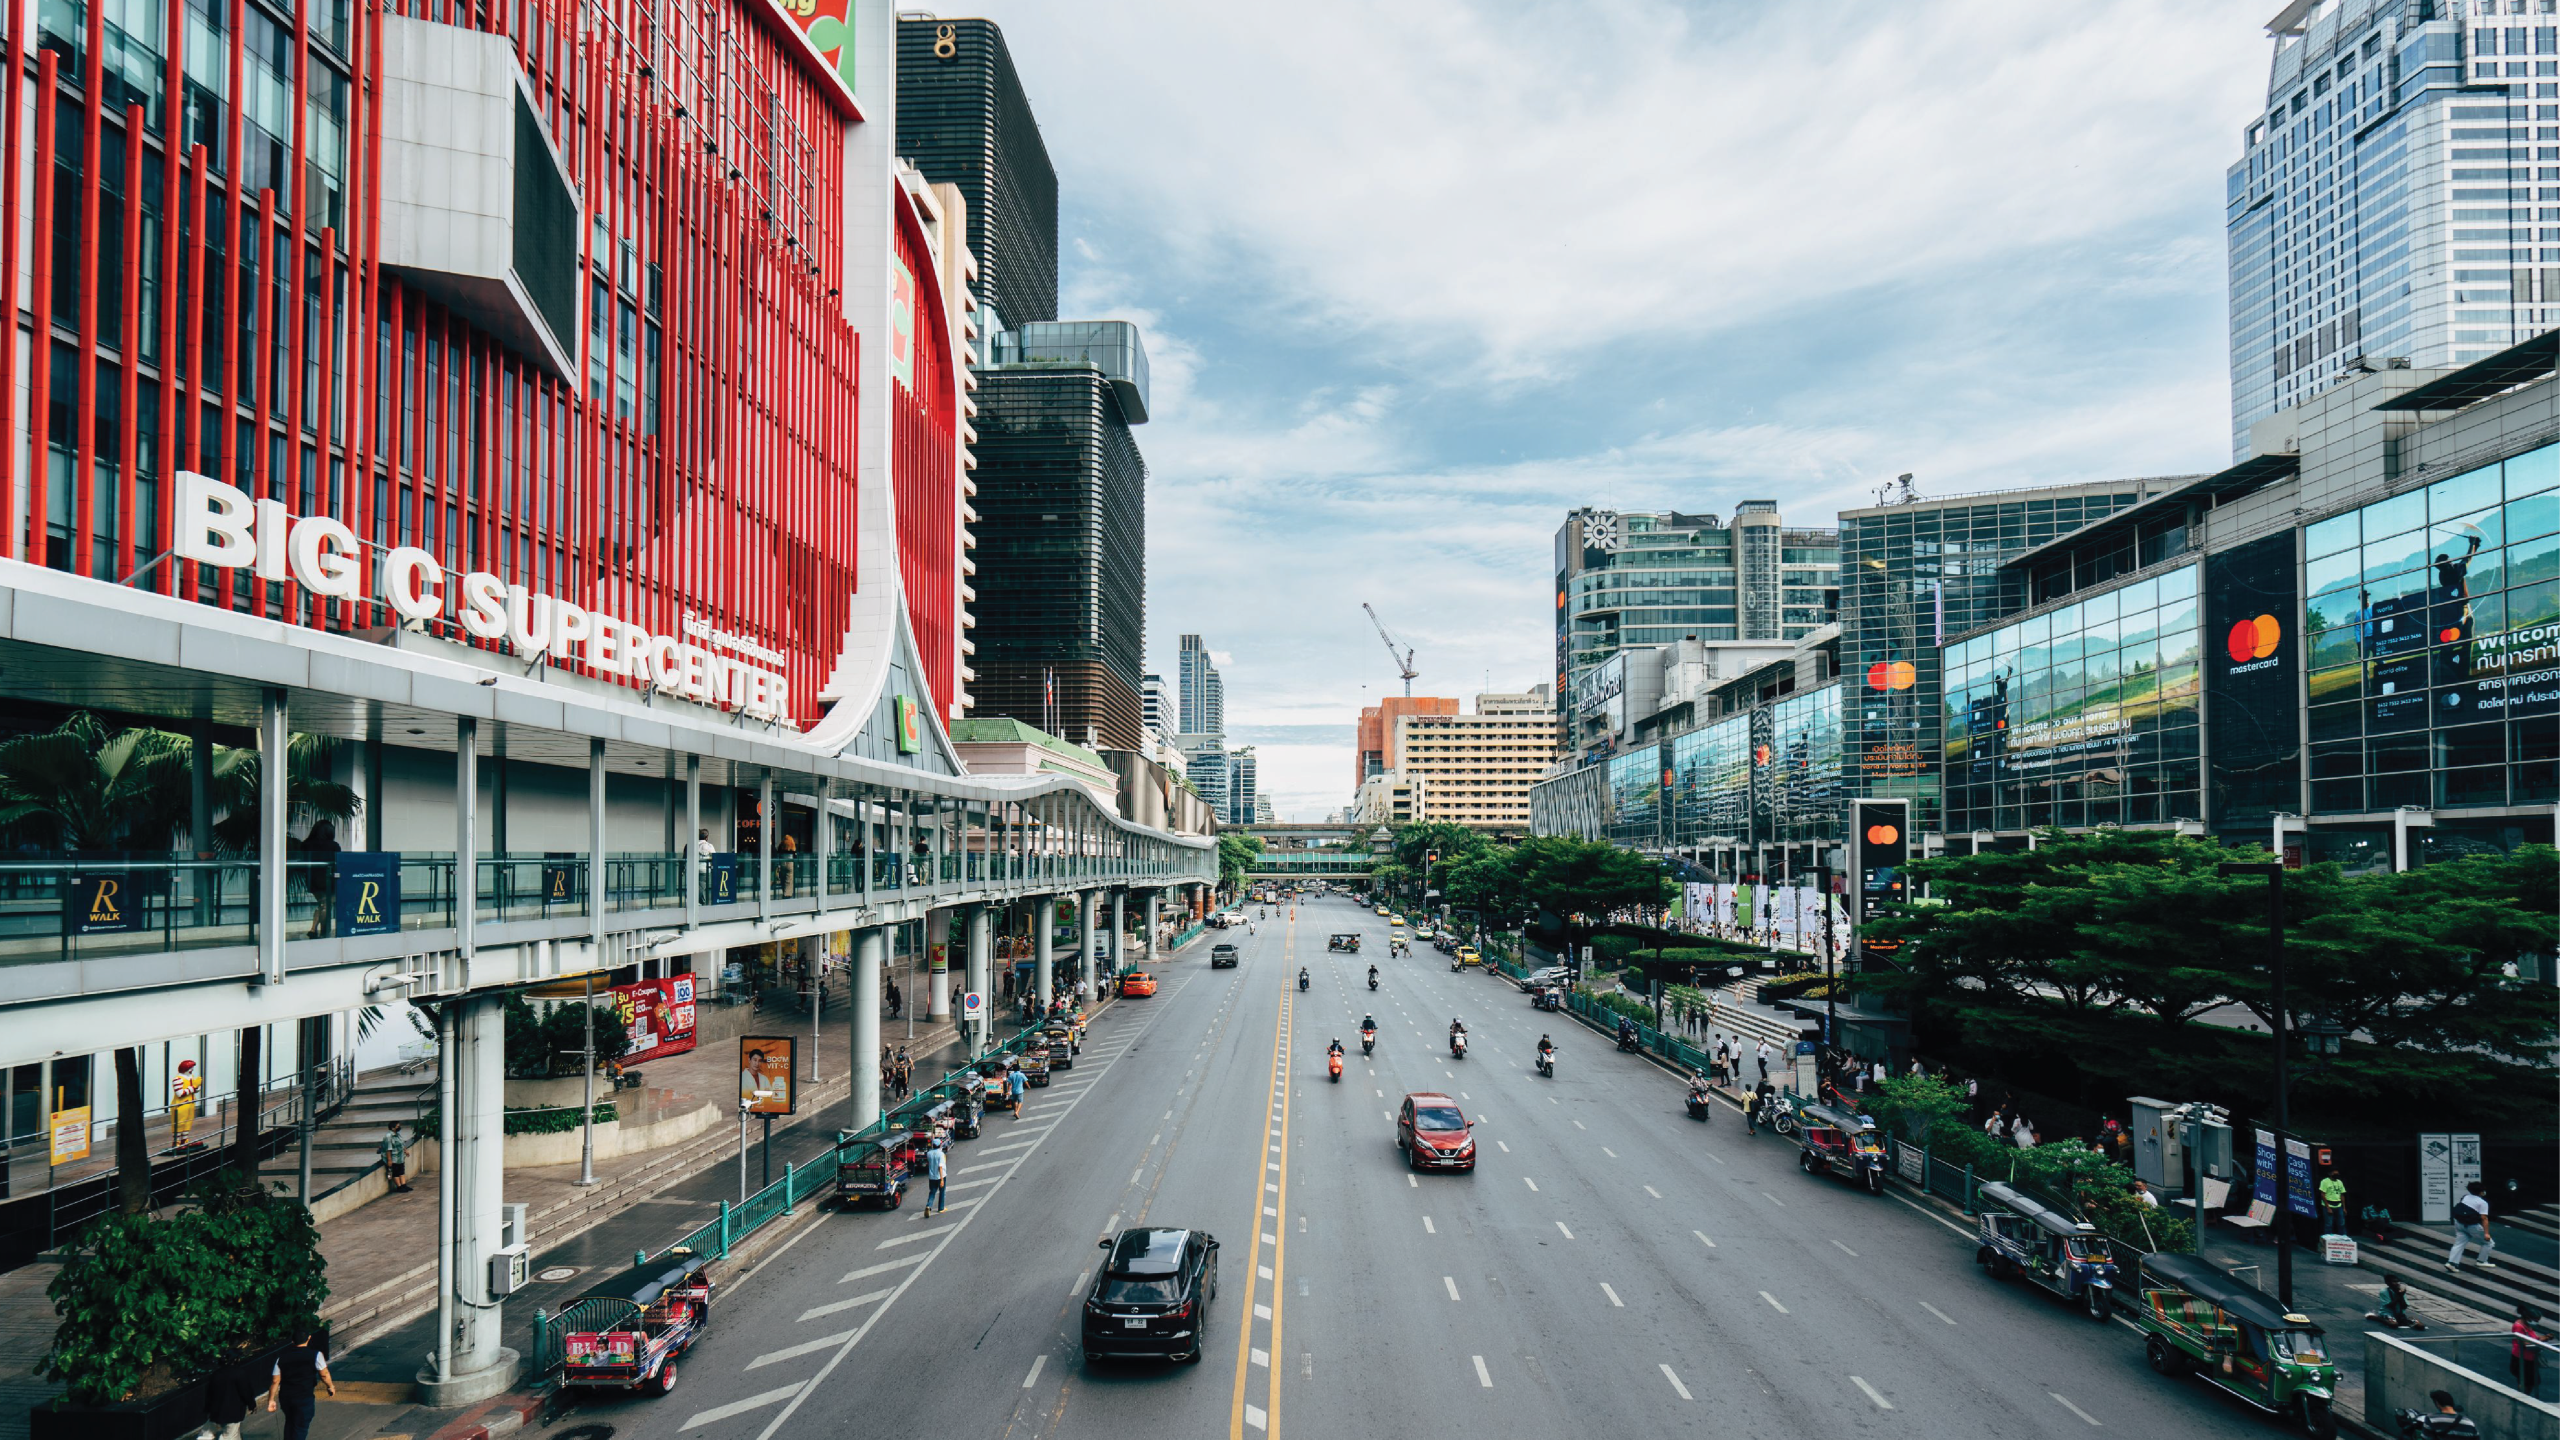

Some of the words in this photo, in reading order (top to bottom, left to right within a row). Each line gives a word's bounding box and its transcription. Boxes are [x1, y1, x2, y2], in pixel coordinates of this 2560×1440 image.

[175, 471, 361, 601] BIG
[384, 547, 443, 620] C
[458, 572, 788, 718] SUPERCENTER
[2230, 656, 2279, 675] mastercard
[2063, 716, 2078, 726] our
[554, 870, 566, 892] R
[719, 870, 729, 892] R
[91, 880, 119, 912] R
[358, 881, 380, 915] R
[89, 912, 120, 921] WALK
[356, 914, 381, 924] WALK
[632, 987, 658, 998] E-Coupon
[2257, 1146, 2276, 1161] Shop
[2256, 1158, 2273, 1170] with
[2287, 1156, 2307, 1170] Cash
[2256, 1168, 2277, 1181] ease
[2288, 1165, 2304, 1178] less
[2259, 1191, 2273, 1202] VISA
[2289, 1185, 2312, 1199] ment
[2288, 1193, 2314, 1206] preferred
[2294, 1203, 2309, 1214] VISA
